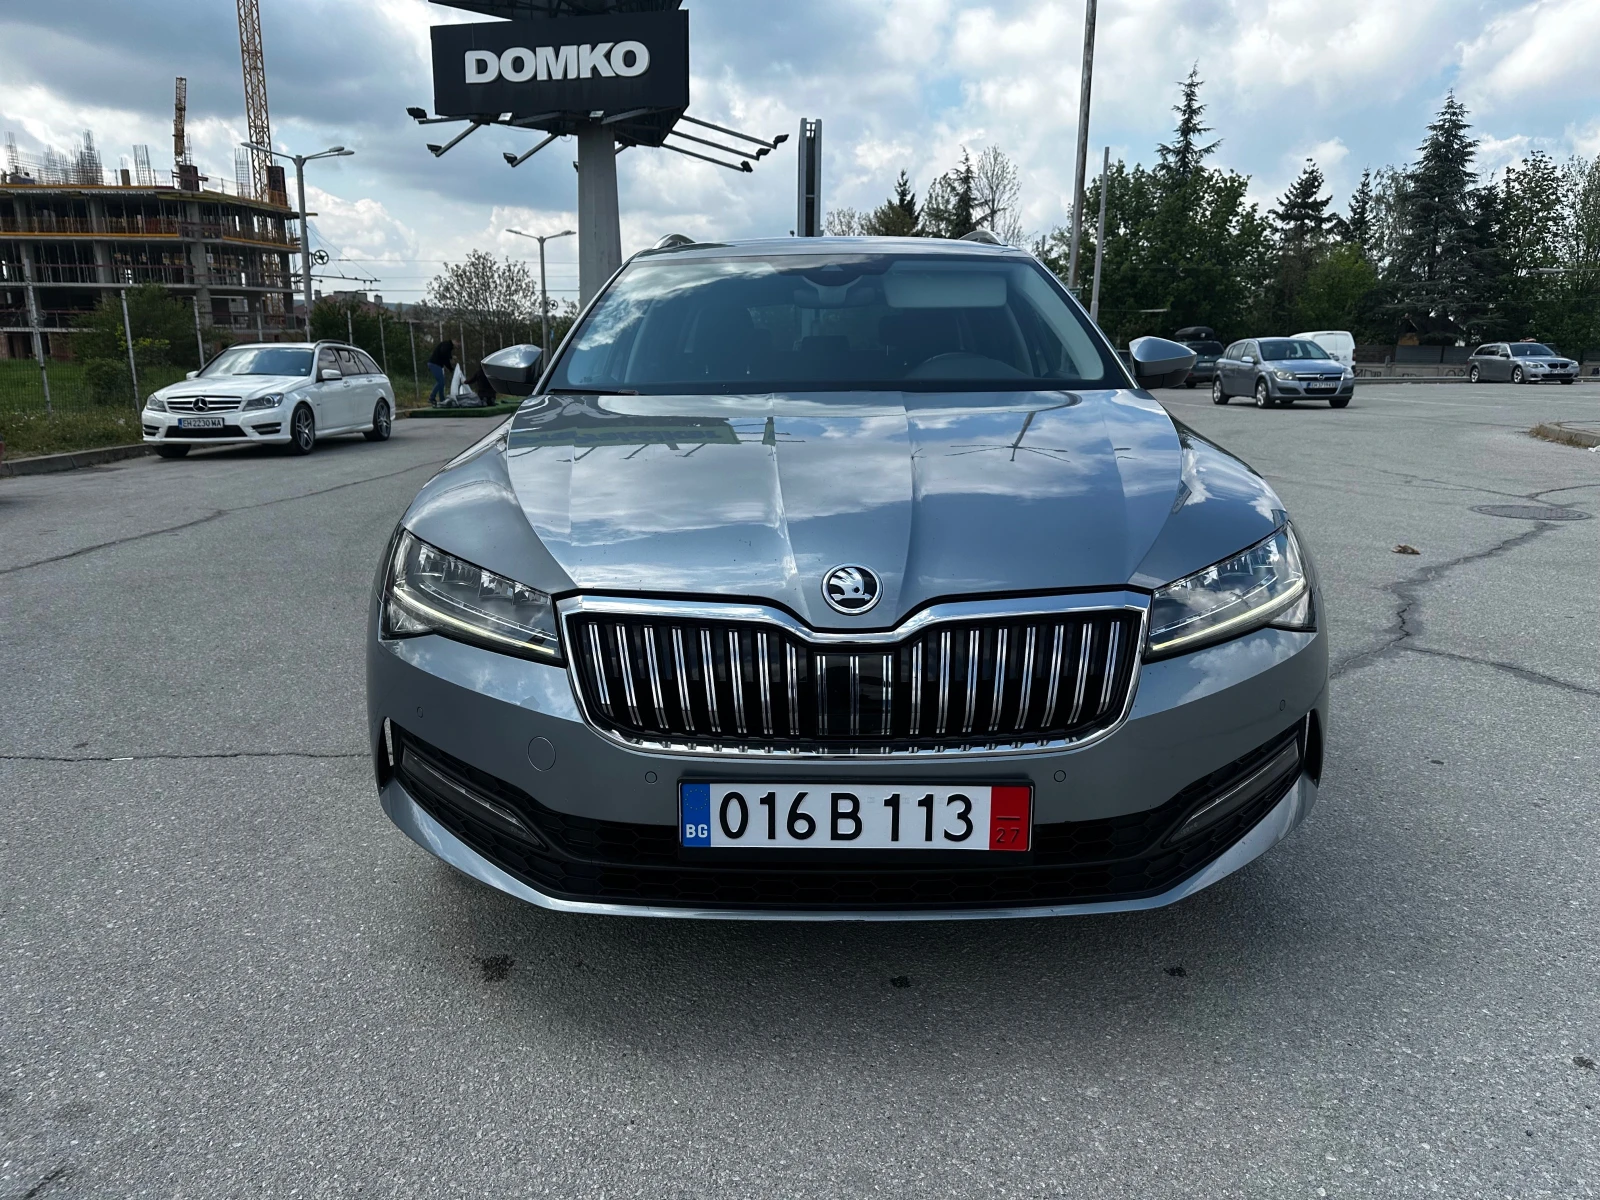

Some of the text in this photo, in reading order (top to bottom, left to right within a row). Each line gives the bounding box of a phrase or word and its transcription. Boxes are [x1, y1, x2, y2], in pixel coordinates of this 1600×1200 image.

[464, 40, 651, 84] DOMKO
[685, 823, 708, 838] BG
[995, 826, 1021, 844] 27
